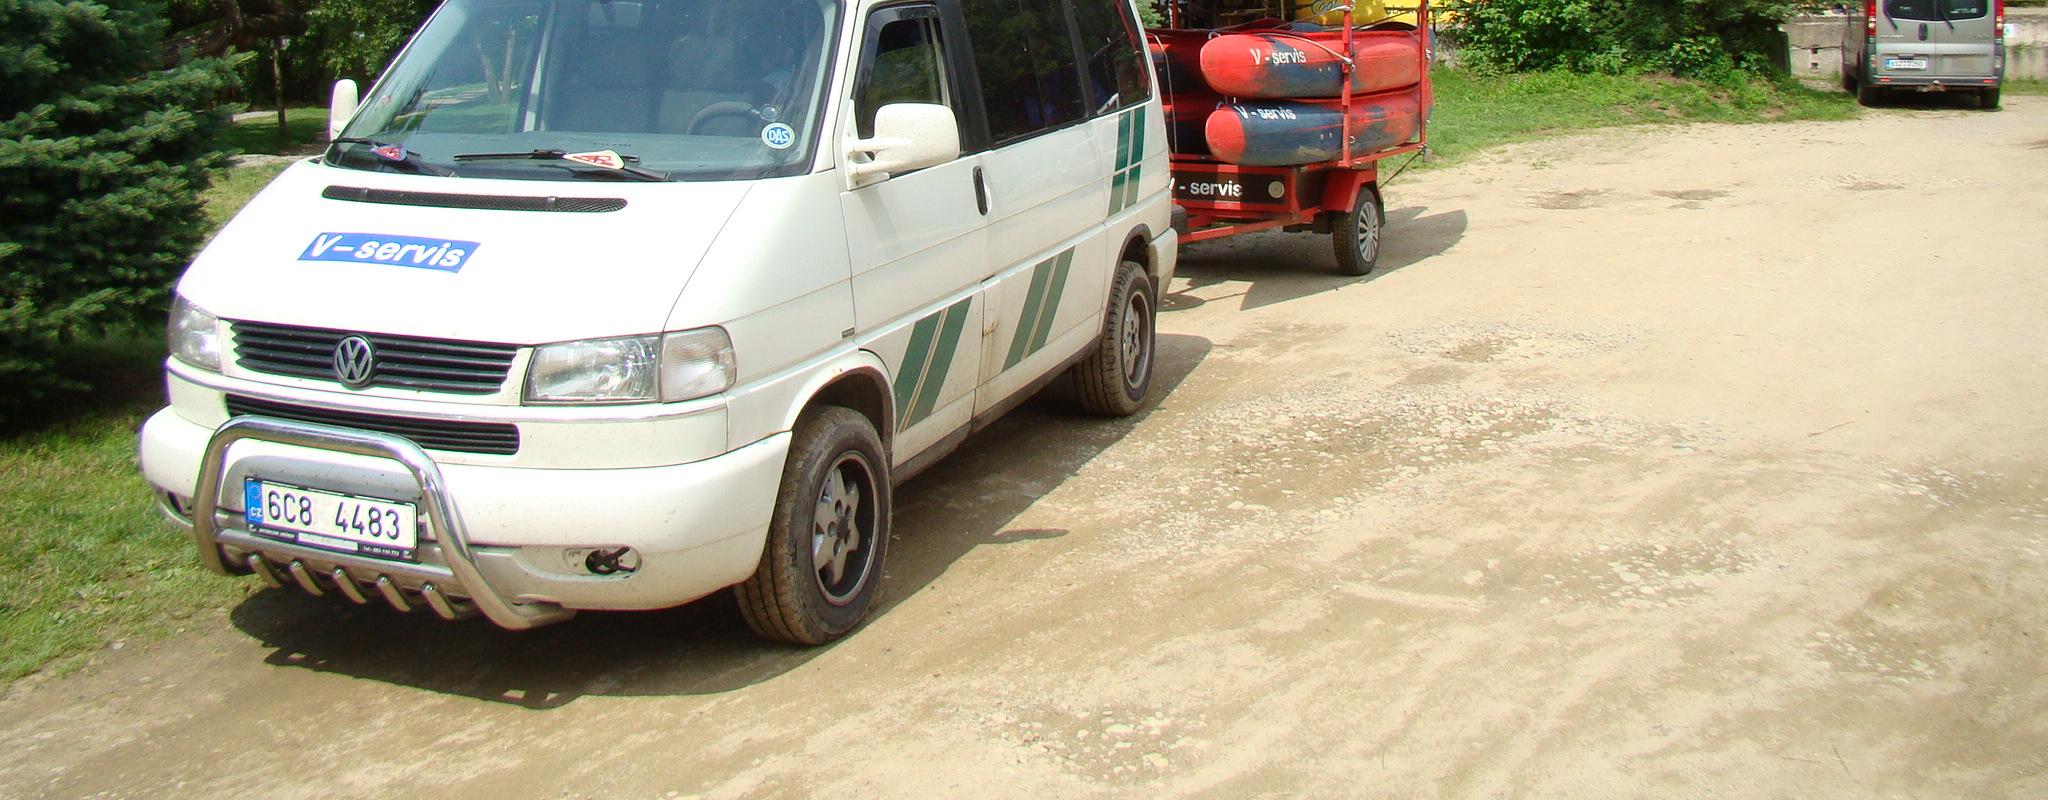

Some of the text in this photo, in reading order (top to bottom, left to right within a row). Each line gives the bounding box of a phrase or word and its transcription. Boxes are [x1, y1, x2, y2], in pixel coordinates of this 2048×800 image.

[250, 506, 263, 518] CZ
[268, 489, 400, 540] 6C8 4483
